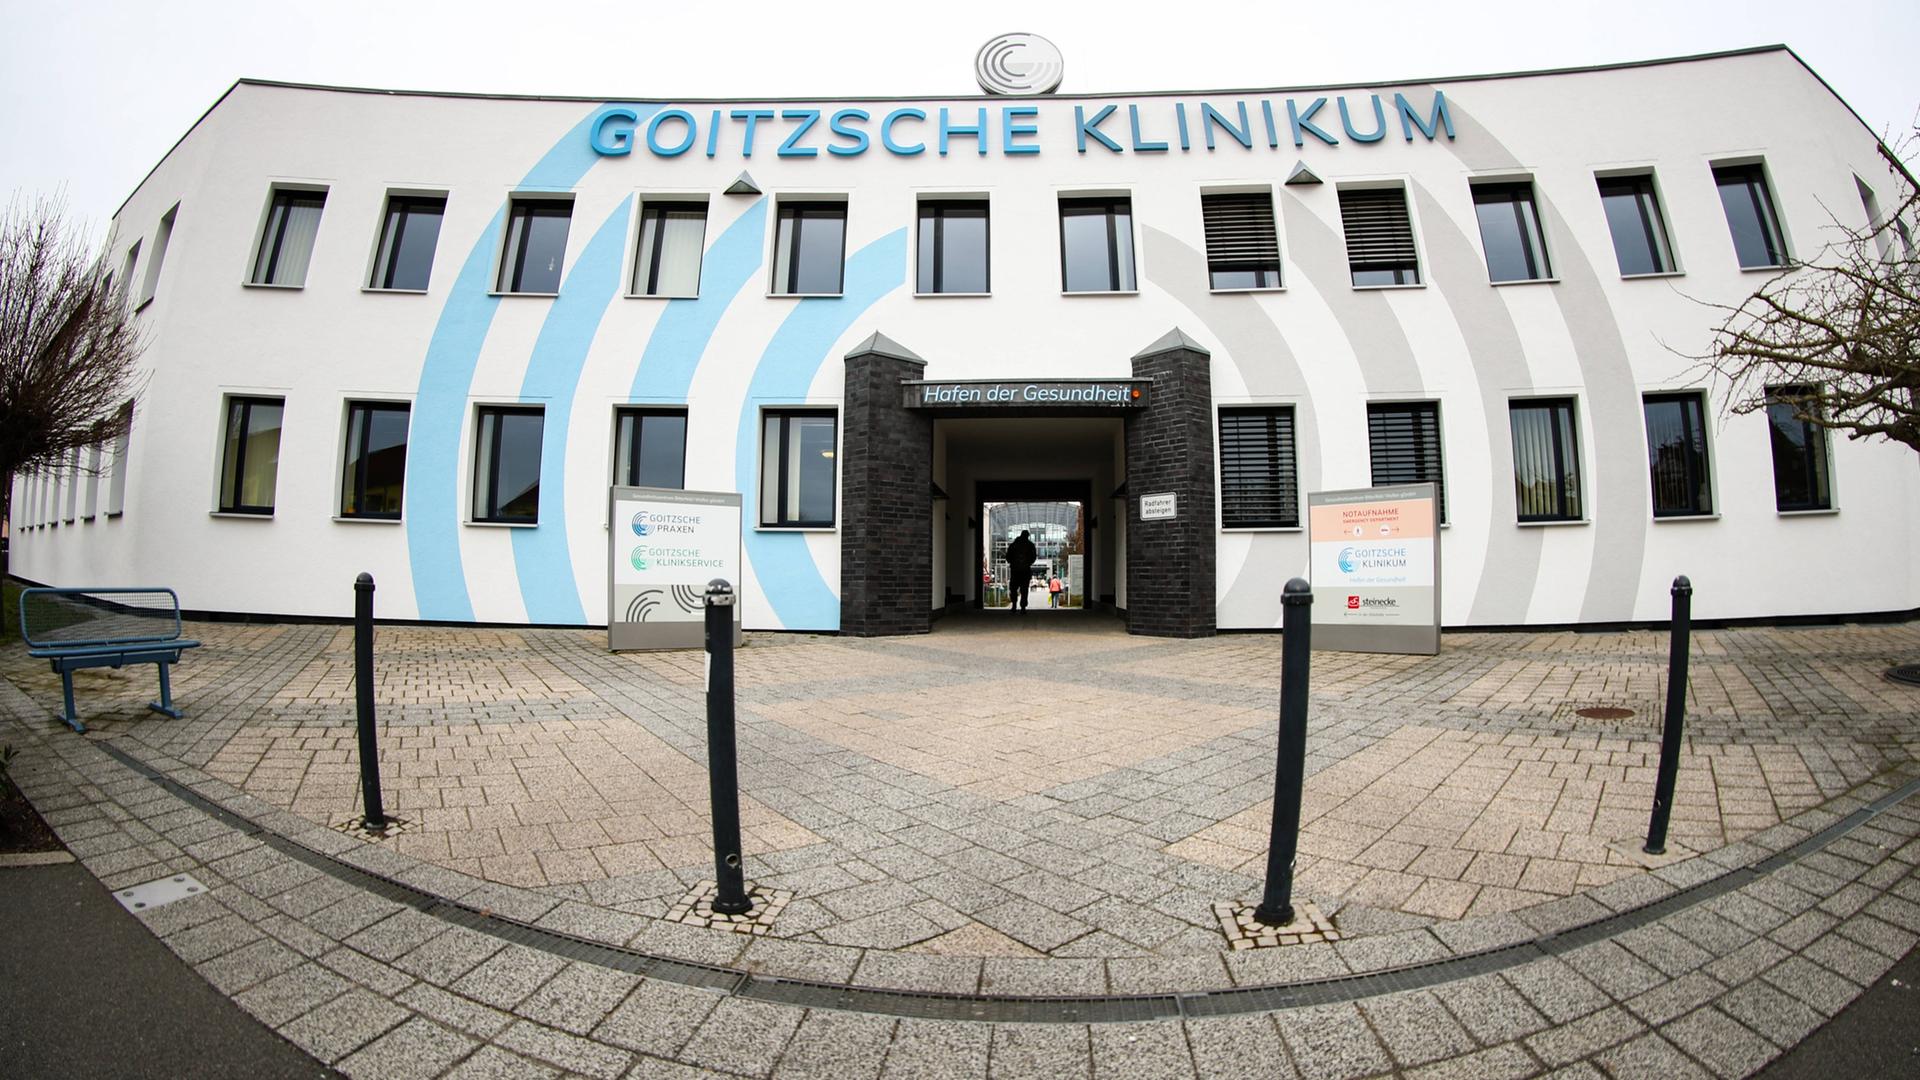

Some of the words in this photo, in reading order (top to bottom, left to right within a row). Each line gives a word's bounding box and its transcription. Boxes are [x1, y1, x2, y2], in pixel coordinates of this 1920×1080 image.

[589, 106, 1041, 159] GOITZSCHE
[1074, 90, 1456, 153] KLINIKUM
[924, 385, 981, 402] Hafen
[987, 385, 1019, 402] der
[1023, 384, 1131, 402] Gesundheit
[1144, 499, 1172, 507] Radfahrer
[1145, 507, 1172, 515] absteigen
[1342, 507, 1399, 518] NOTAUFNAHME
[649, 514, 701, 525] GOITZSCHE
[657, 524, 695, 534] PRAXEN
[648, 547, 700, 558] GOITZSCHE
[1354, 548, 1407, 558] GOITZSCHE
[656, 557, 724, 568] KLINIKSERVICE
[1362, 558, 1407, 568] KLINIKUM
[1362, 597, 1397, 607] steinecke
